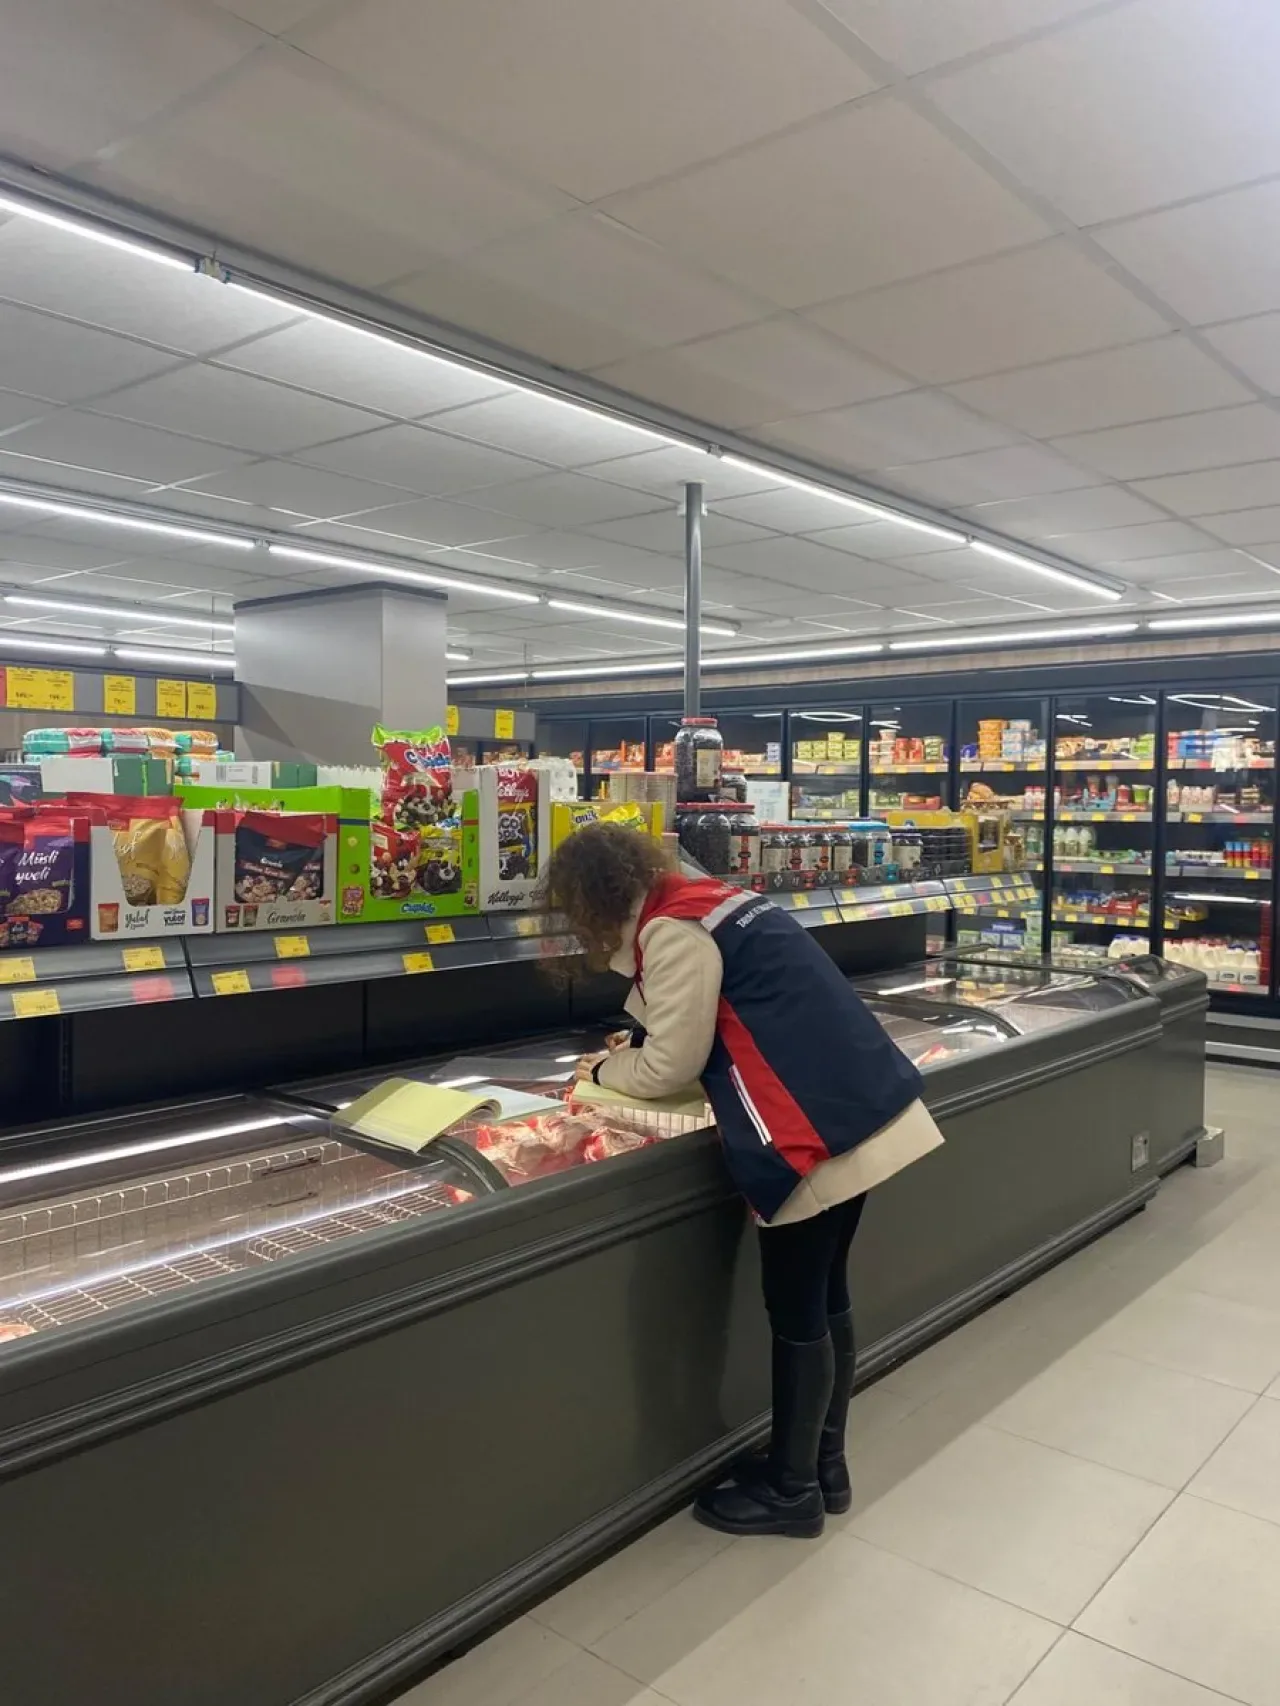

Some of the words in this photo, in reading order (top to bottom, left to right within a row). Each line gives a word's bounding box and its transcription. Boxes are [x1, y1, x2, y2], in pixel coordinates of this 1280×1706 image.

[18, 850, 59, 866] Müsli
[487, 889, 526, 906] Kellogg's
[266, 908, 307, 925] Granola
